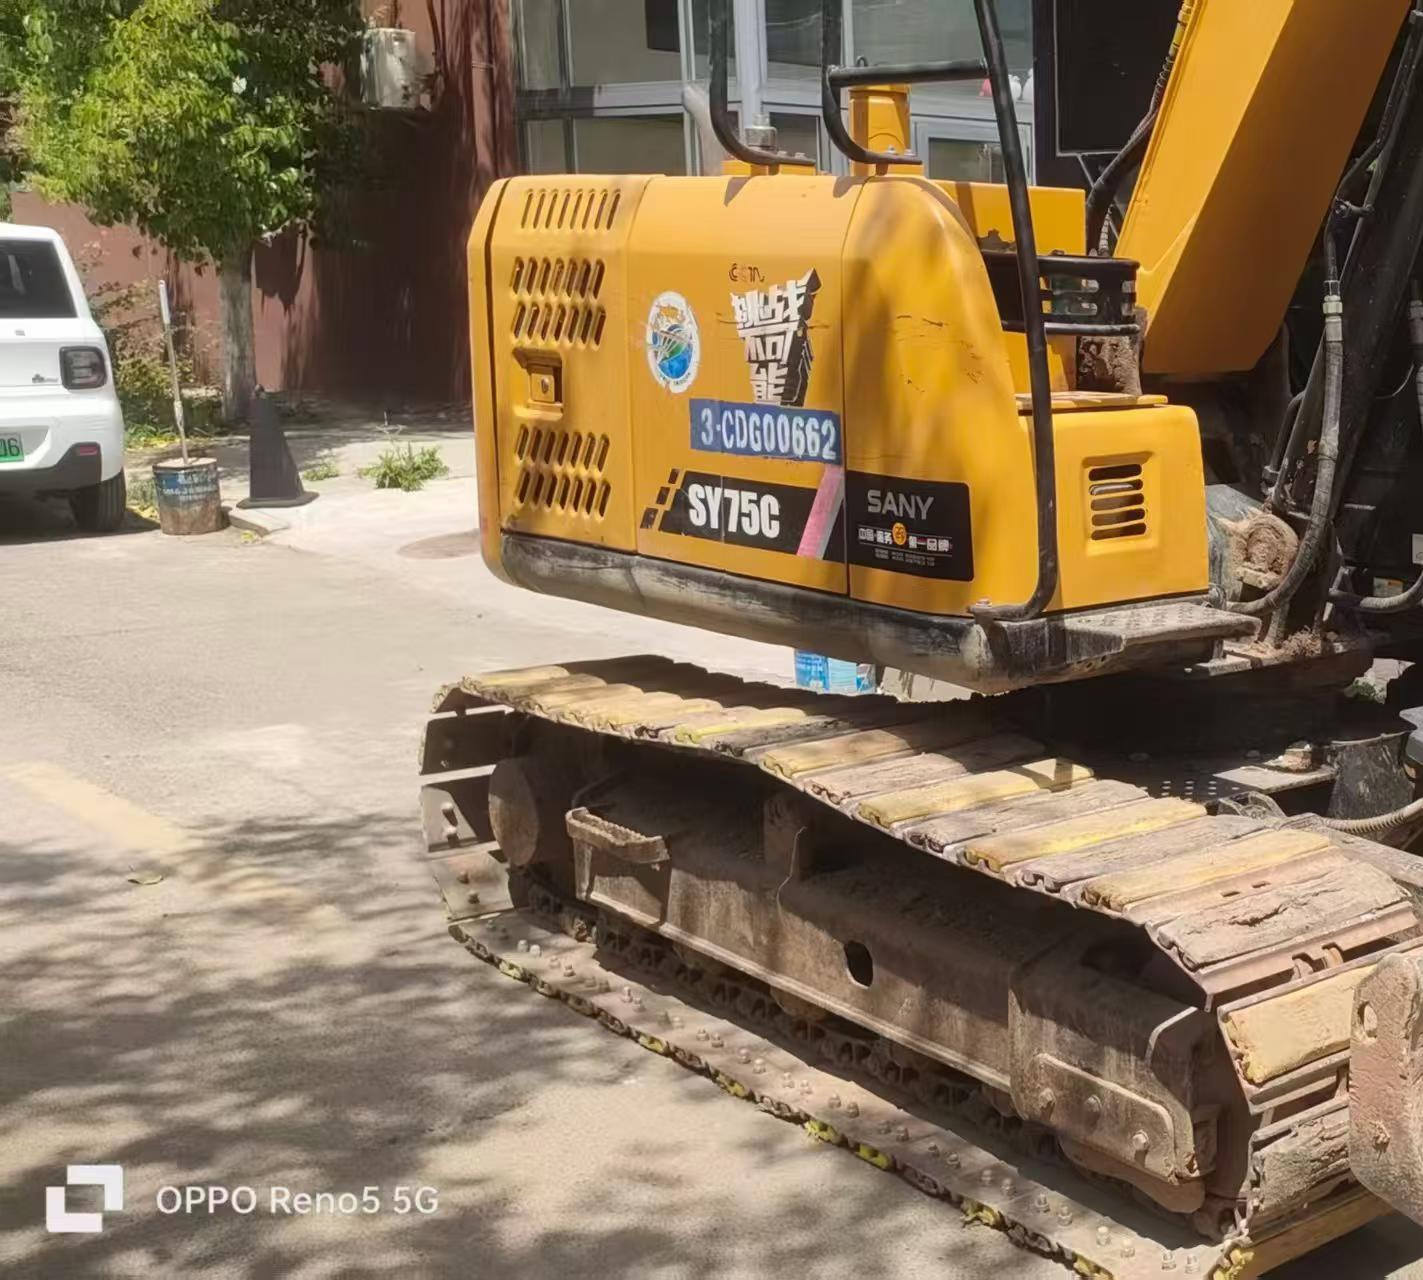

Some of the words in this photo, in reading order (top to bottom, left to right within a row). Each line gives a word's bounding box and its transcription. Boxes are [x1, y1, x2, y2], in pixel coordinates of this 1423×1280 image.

[701, 407, 836, 460] 3-CDG00662
[688, 483, 780, 539] SY75C
[867, 489, 934, 520] SANY
